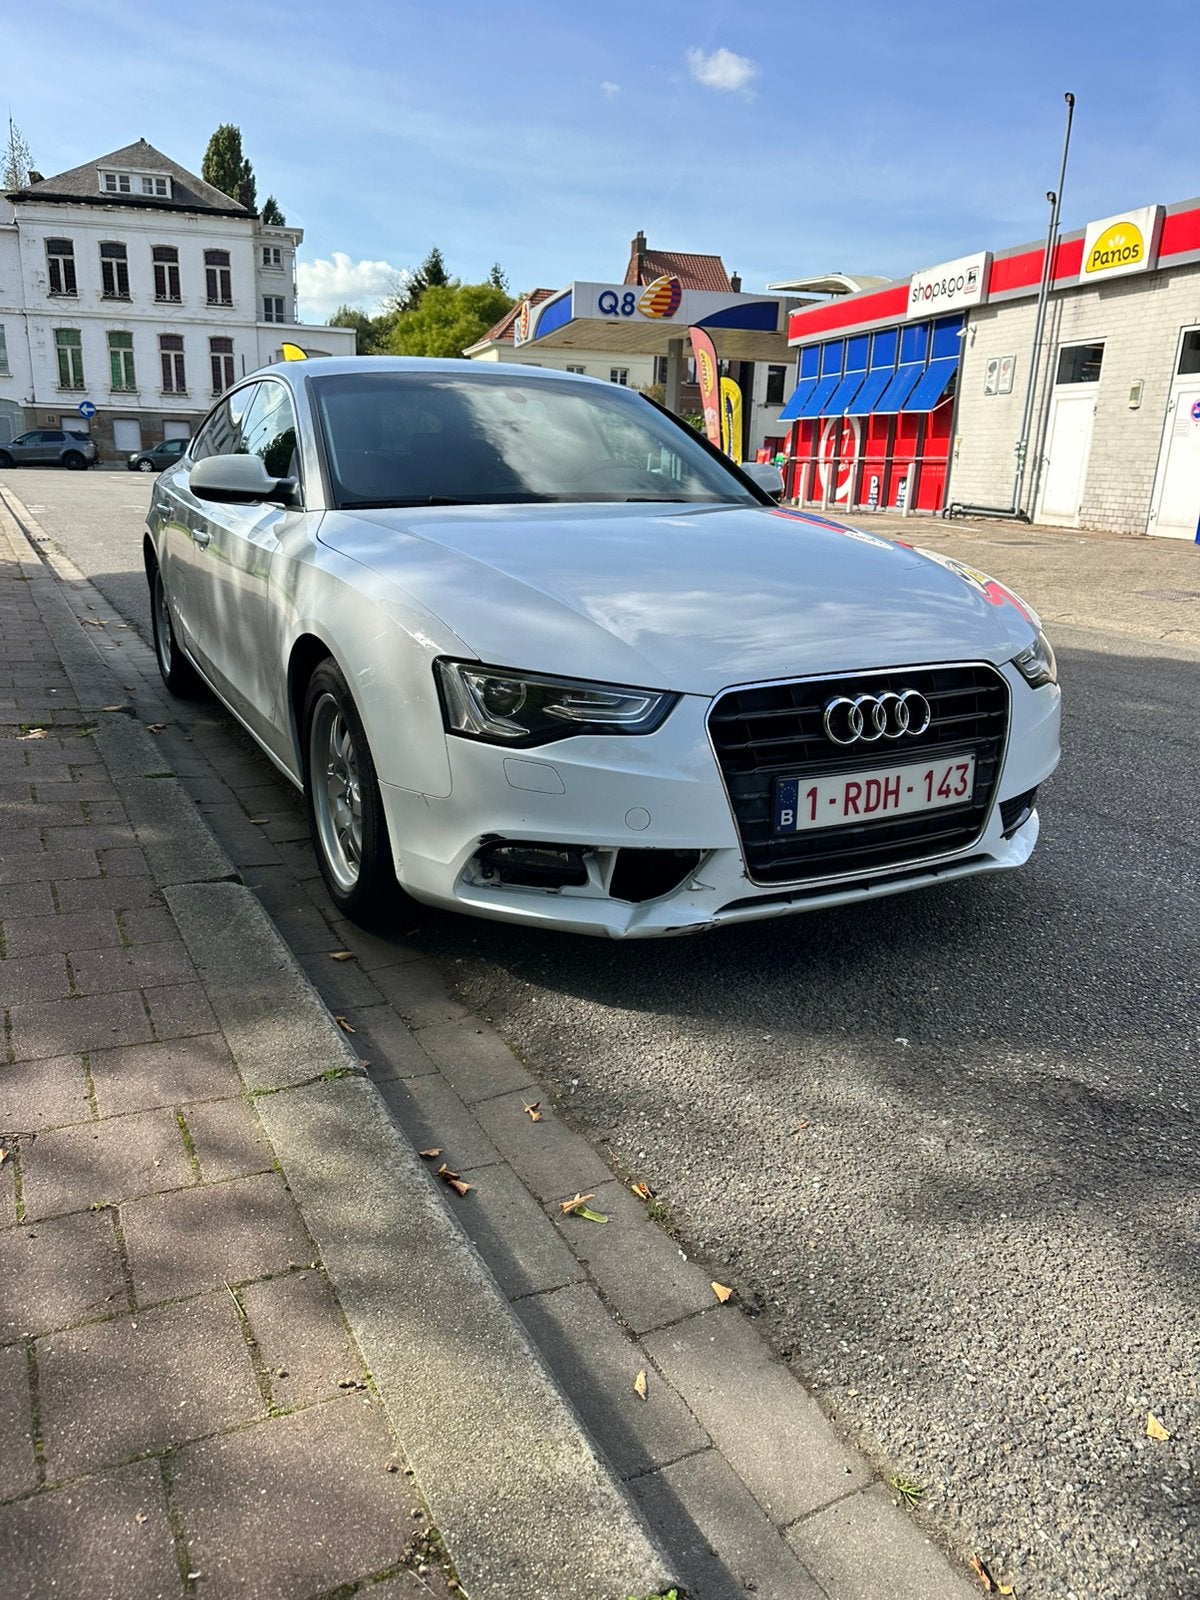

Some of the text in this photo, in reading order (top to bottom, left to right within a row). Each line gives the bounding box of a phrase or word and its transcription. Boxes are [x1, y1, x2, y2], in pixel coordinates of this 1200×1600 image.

[1092, 244, 1140, 267] Panos
[912, 275, 964, 302] shop&go
[598, 290, 636, 316] Q8
[780, 809, 794, 825] B
